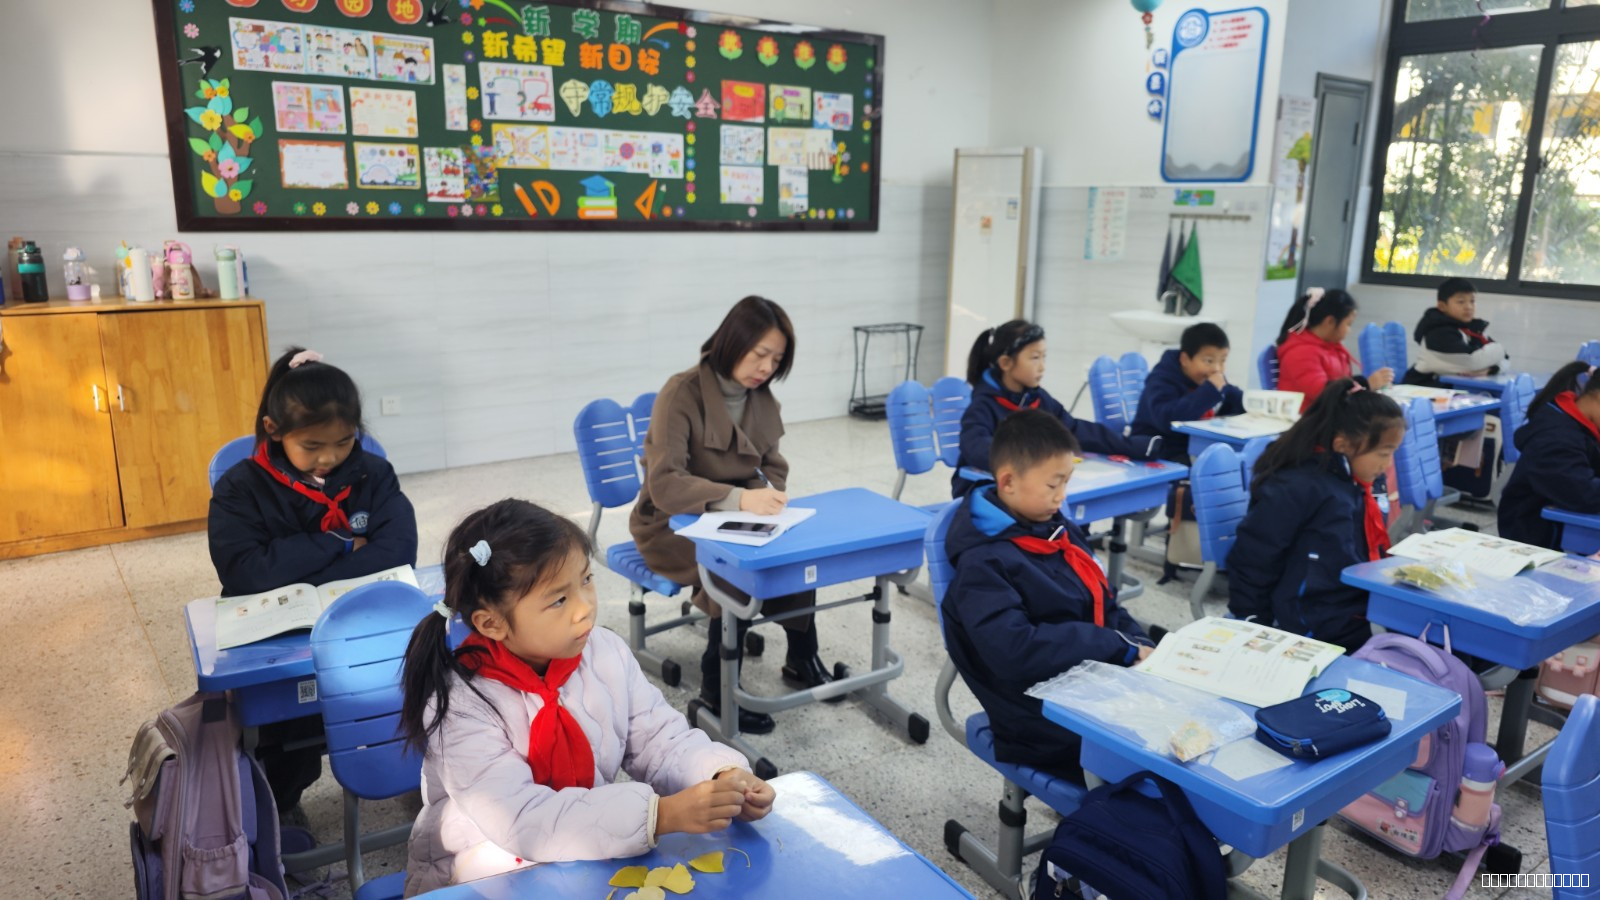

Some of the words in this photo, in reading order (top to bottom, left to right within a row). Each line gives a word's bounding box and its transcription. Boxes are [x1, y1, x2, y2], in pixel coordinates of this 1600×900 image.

[521, 5, 642, 45] 新学期
[482, 30, 566, 67] 新希望
[559, 79, 721, 120] 守常规护安全
